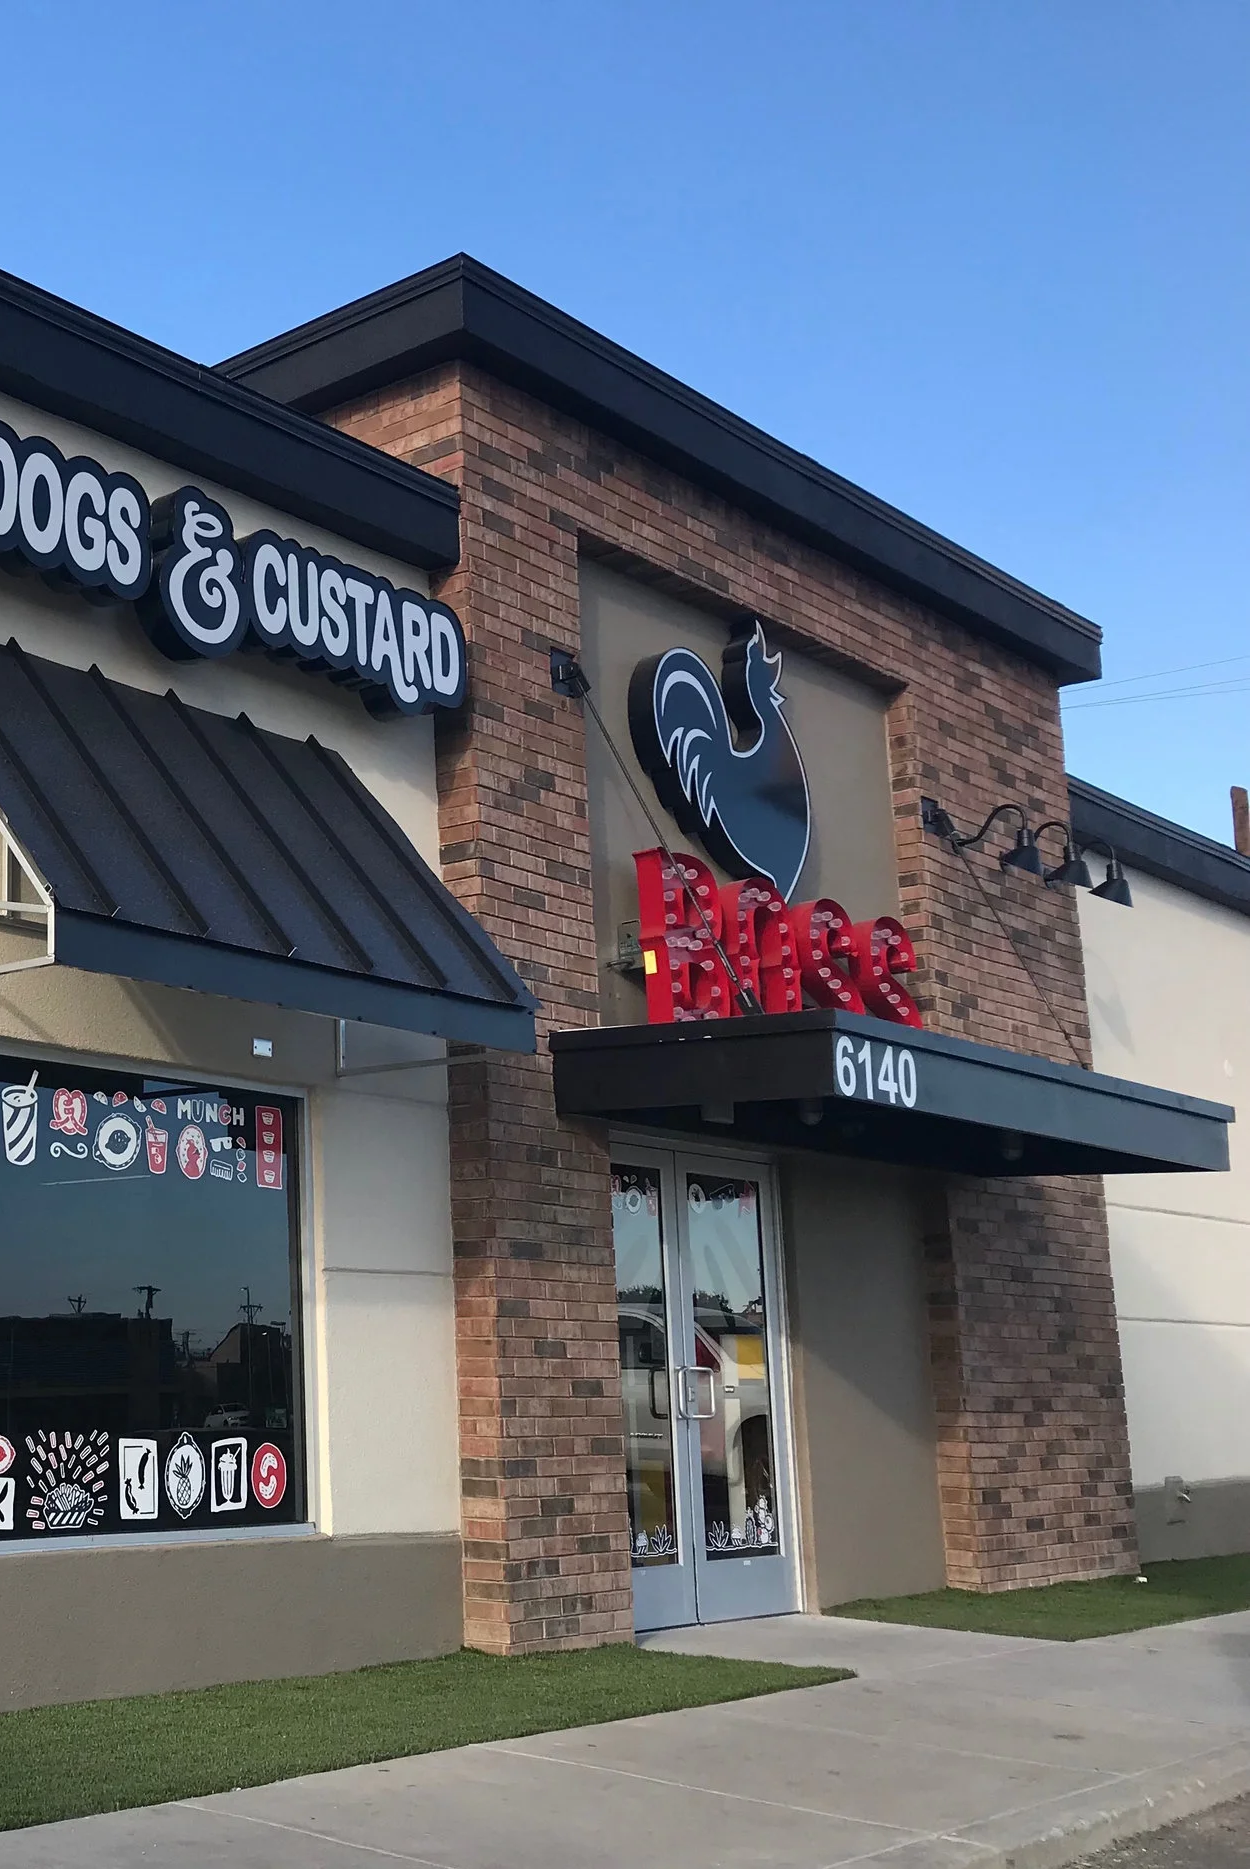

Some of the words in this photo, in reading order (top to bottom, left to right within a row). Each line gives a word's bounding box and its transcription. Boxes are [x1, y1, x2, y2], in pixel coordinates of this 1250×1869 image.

[168, 500, 240, 644] &
[253, 543, 459, 703] CUSTARD
[836, 1036, 917, 1108] 6140
[177, 1098, 245, 1126] MUNCH
